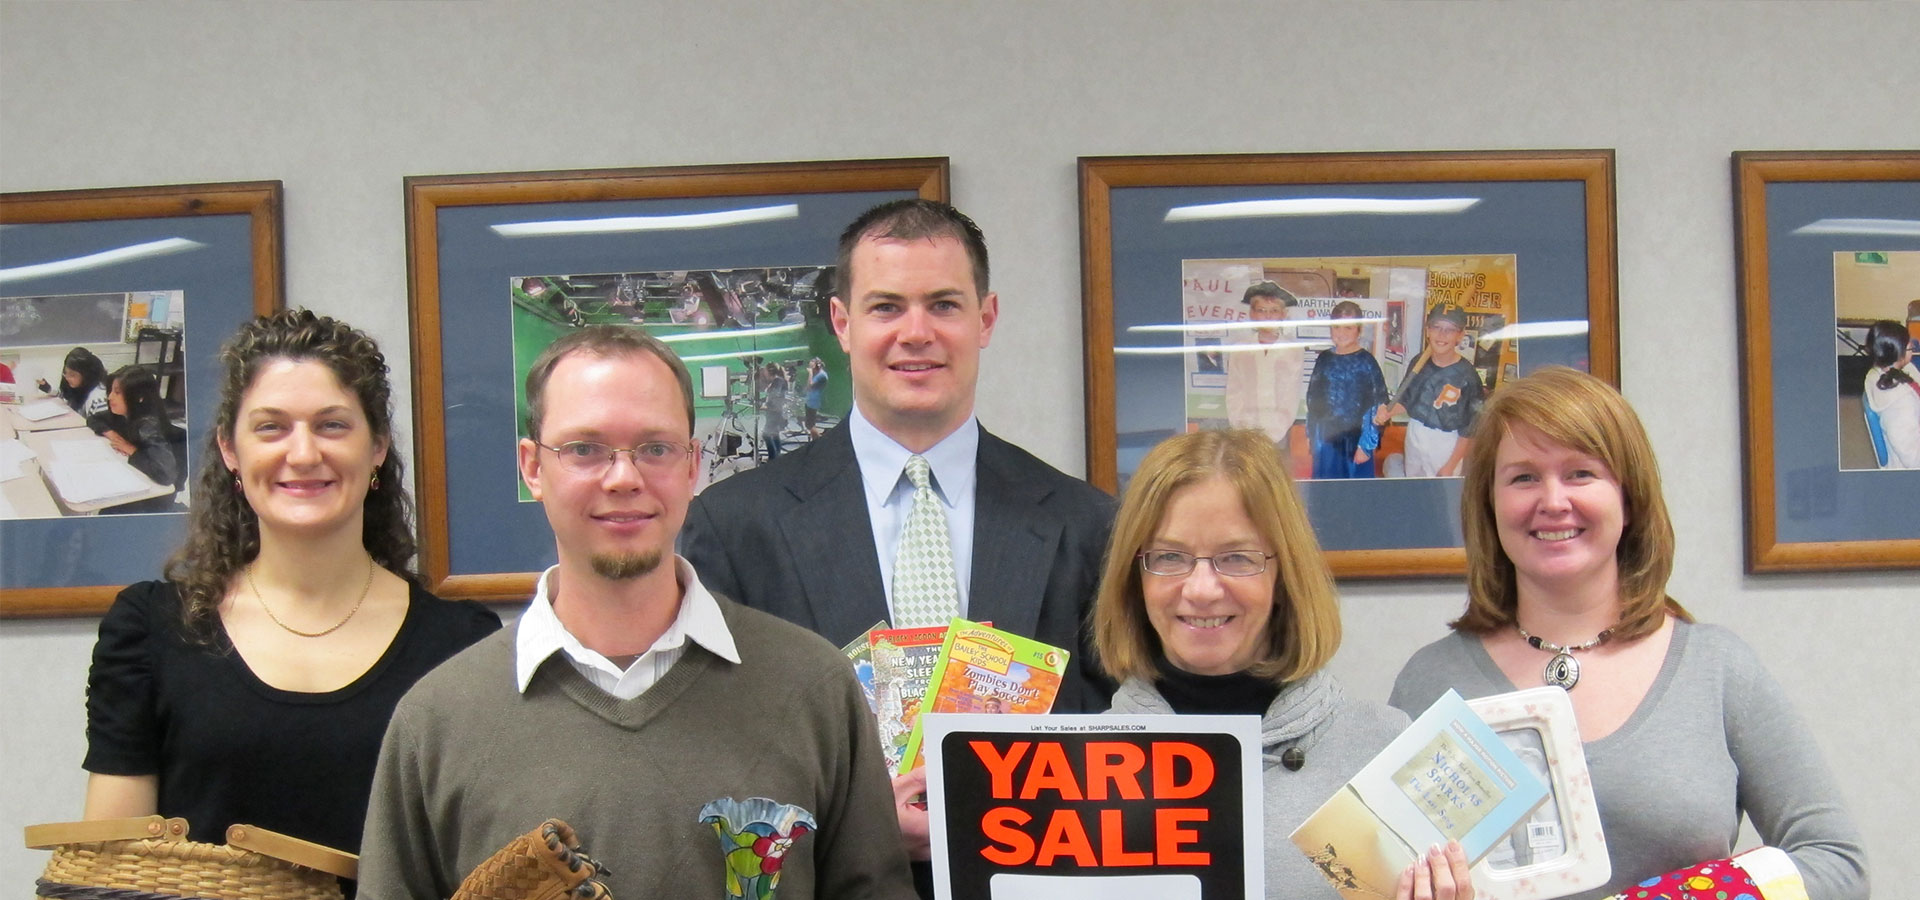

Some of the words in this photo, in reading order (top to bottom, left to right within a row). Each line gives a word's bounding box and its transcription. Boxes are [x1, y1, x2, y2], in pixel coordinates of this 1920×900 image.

[1427, 271, 1486, 289] HONUS
[1297, 299, 1336, 308] MARTHA
[1433, 384, 1461, 409] P
[891, 656, 915, 667] NEW
[954, 642, 980, 655] BAILEY
[980, 650, 1007, 666] SCHOOL
[970, 657, 987, 667] KIDS
[906, 667, 935, 678] SLEE
[963, 667, 1007, 688] Zombies
[1010, 681, 1040, 698] Don't
[900, 687, 928, 698] BLAC
[968, 679, 990, 696] Play
[992, 687, 1030, 705] Soccer
[968, 741, 1215, 801] YARD
[1431, 752, 1481, 806] NICHOLAS
[1427, 768, 1465, 809] SPARKS
[980, 806, 1211, 867] SALE
